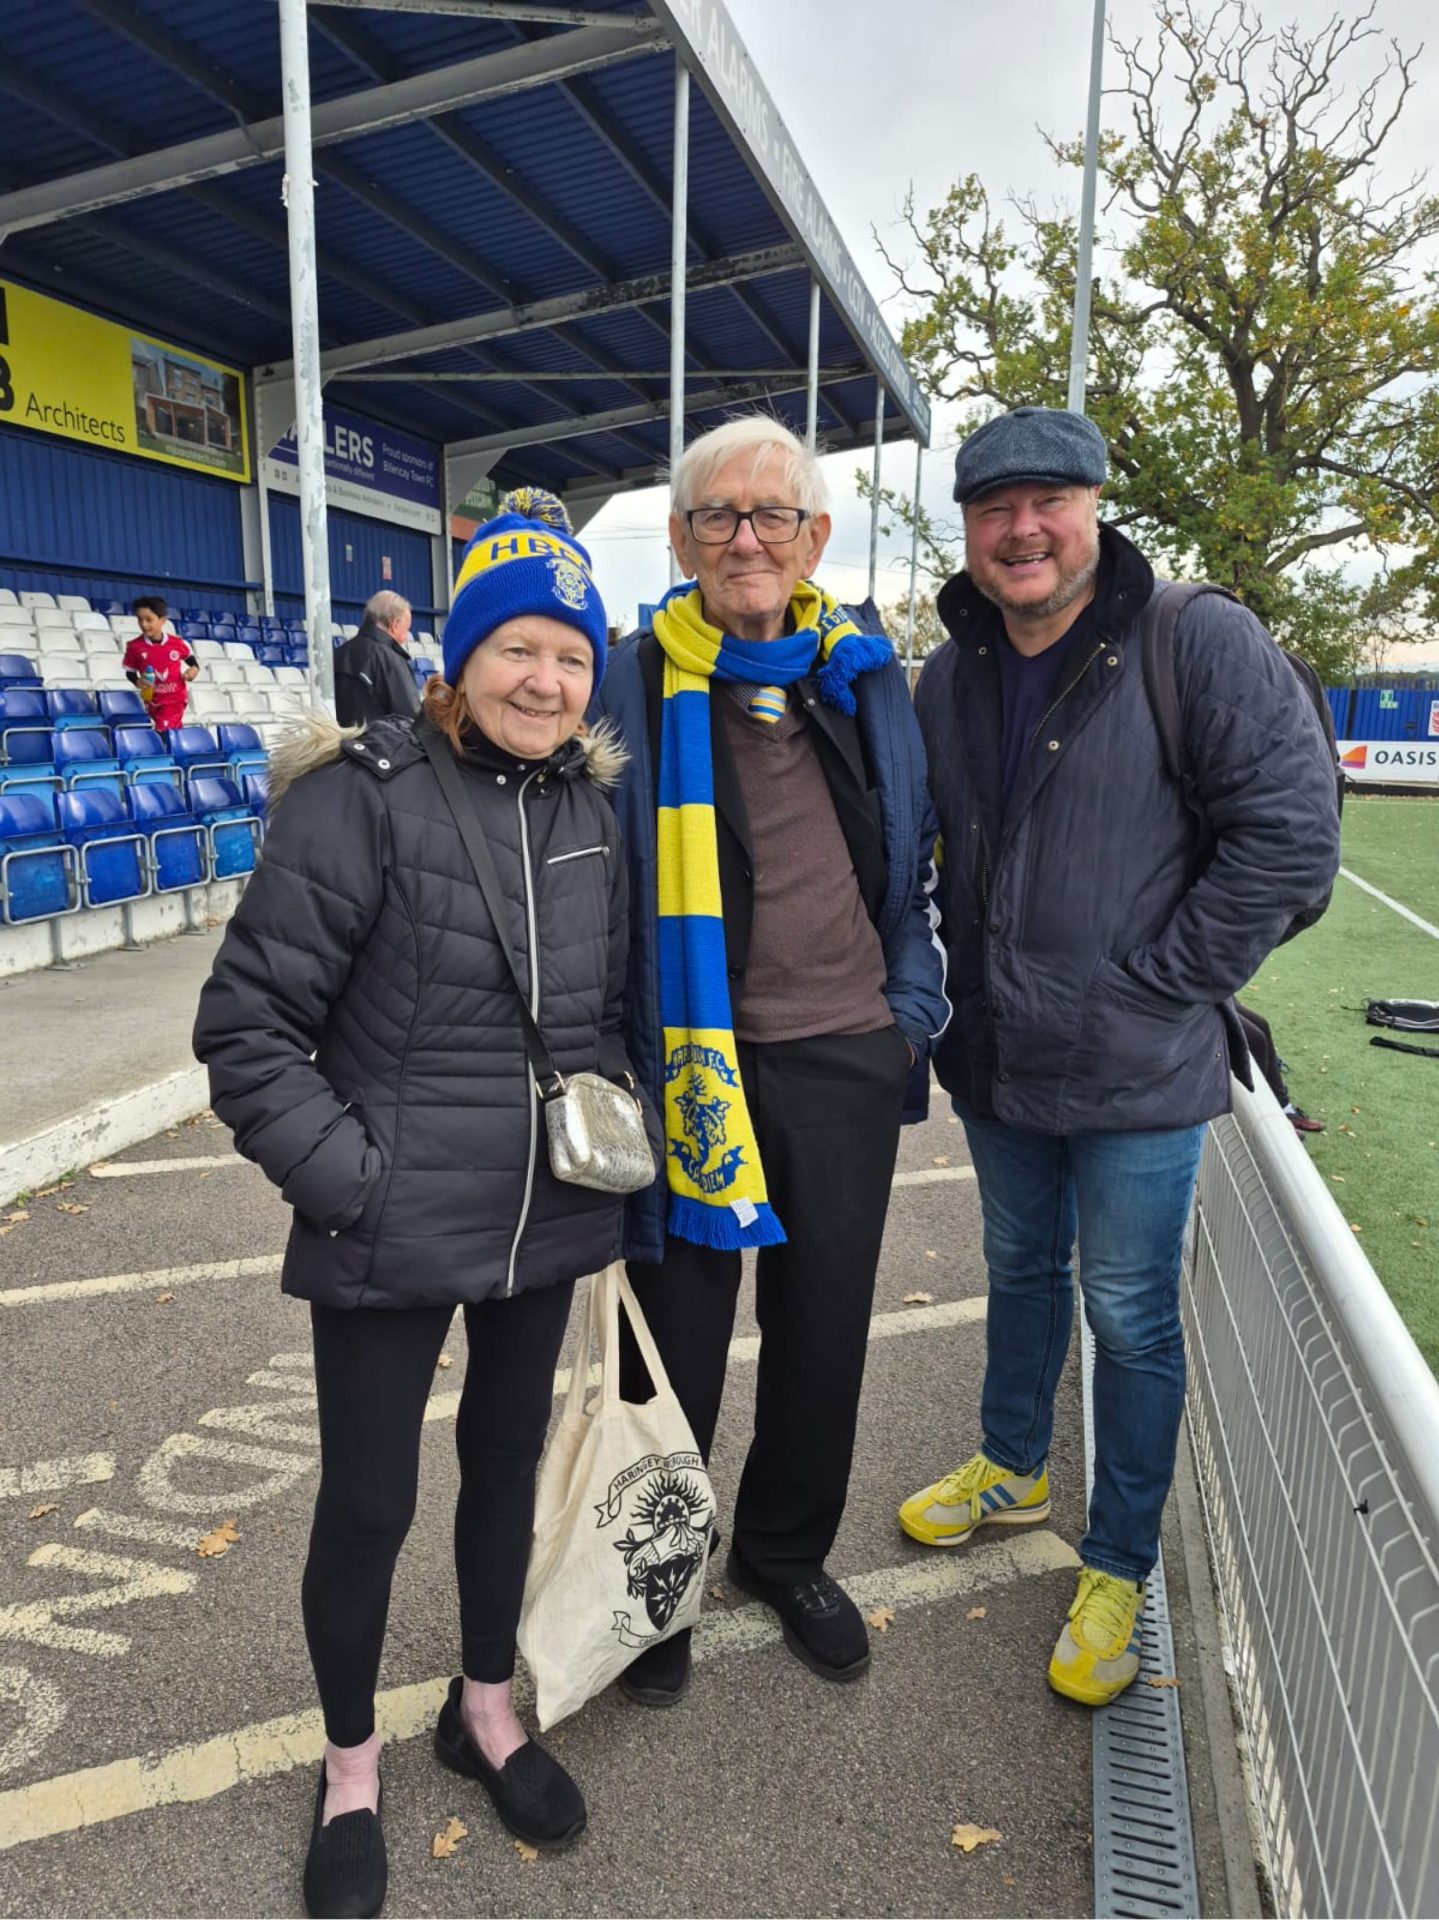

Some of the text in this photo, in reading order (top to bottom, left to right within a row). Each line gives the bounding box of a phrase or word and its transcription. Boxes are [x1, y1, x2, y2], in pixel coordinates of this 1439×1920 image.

[707, 5, 769, 154] ALARMS
[782, 142, 804, 220] FIRE
[805, 192, 842, 284] ALARMS
[25, 392, 126, 444] Architects
[382, 442, 401, 460] Proud
[401, 449, 427, 470] sponsors
[383, 460, 434, 488] Billericay Town FC
[1375, 750, 1437, 766] OASIS
[613, 1457, 660, 1491] HARINGEY
